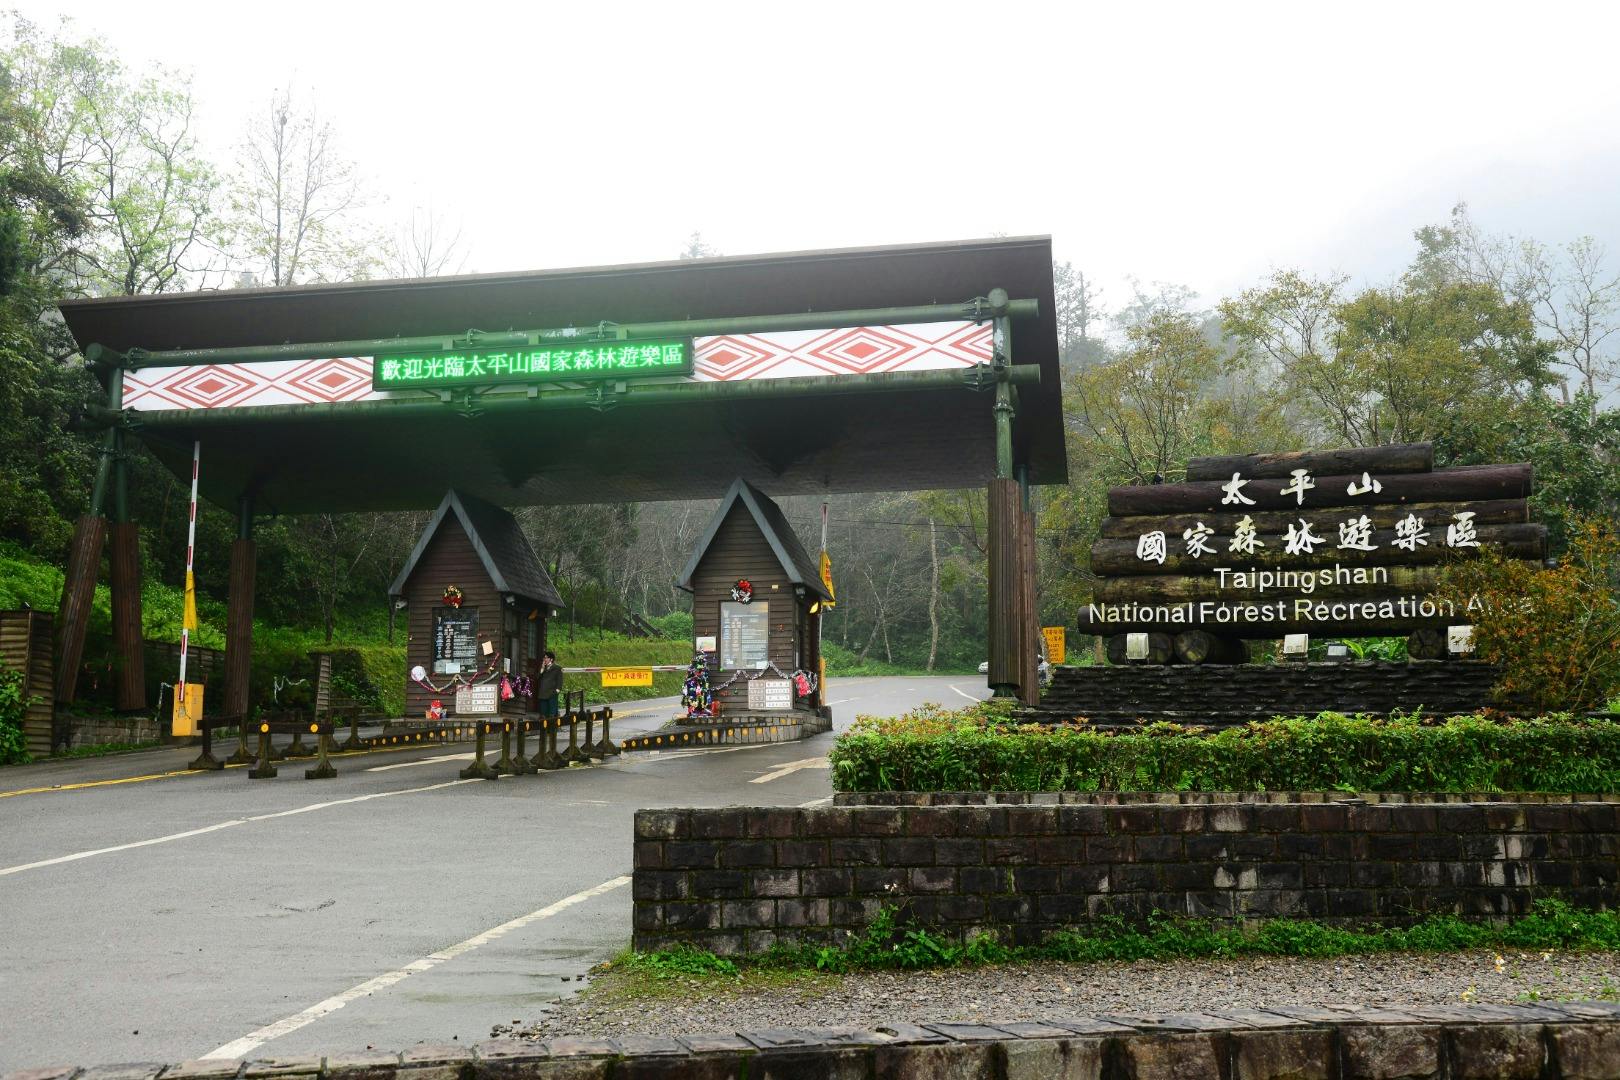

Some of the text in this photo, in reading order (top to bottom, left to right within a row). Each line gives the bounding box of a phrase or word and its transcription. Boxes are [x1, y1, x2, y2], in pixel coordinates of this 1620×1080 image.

[382, 344, 684, 380] 歡迎光臨太平山國家森林遊樂區
[1221, 468, 1384, 506] 太平山
[1136, 511, 1482, 565] 國家森林遊樂區
[1213, 563, 1388, 593] Taipingshan
[1089, 601, 1193, 624] National
[1200, 601, 1287, 624] Forest
[1294, 595, 1455, 621] Recreation
